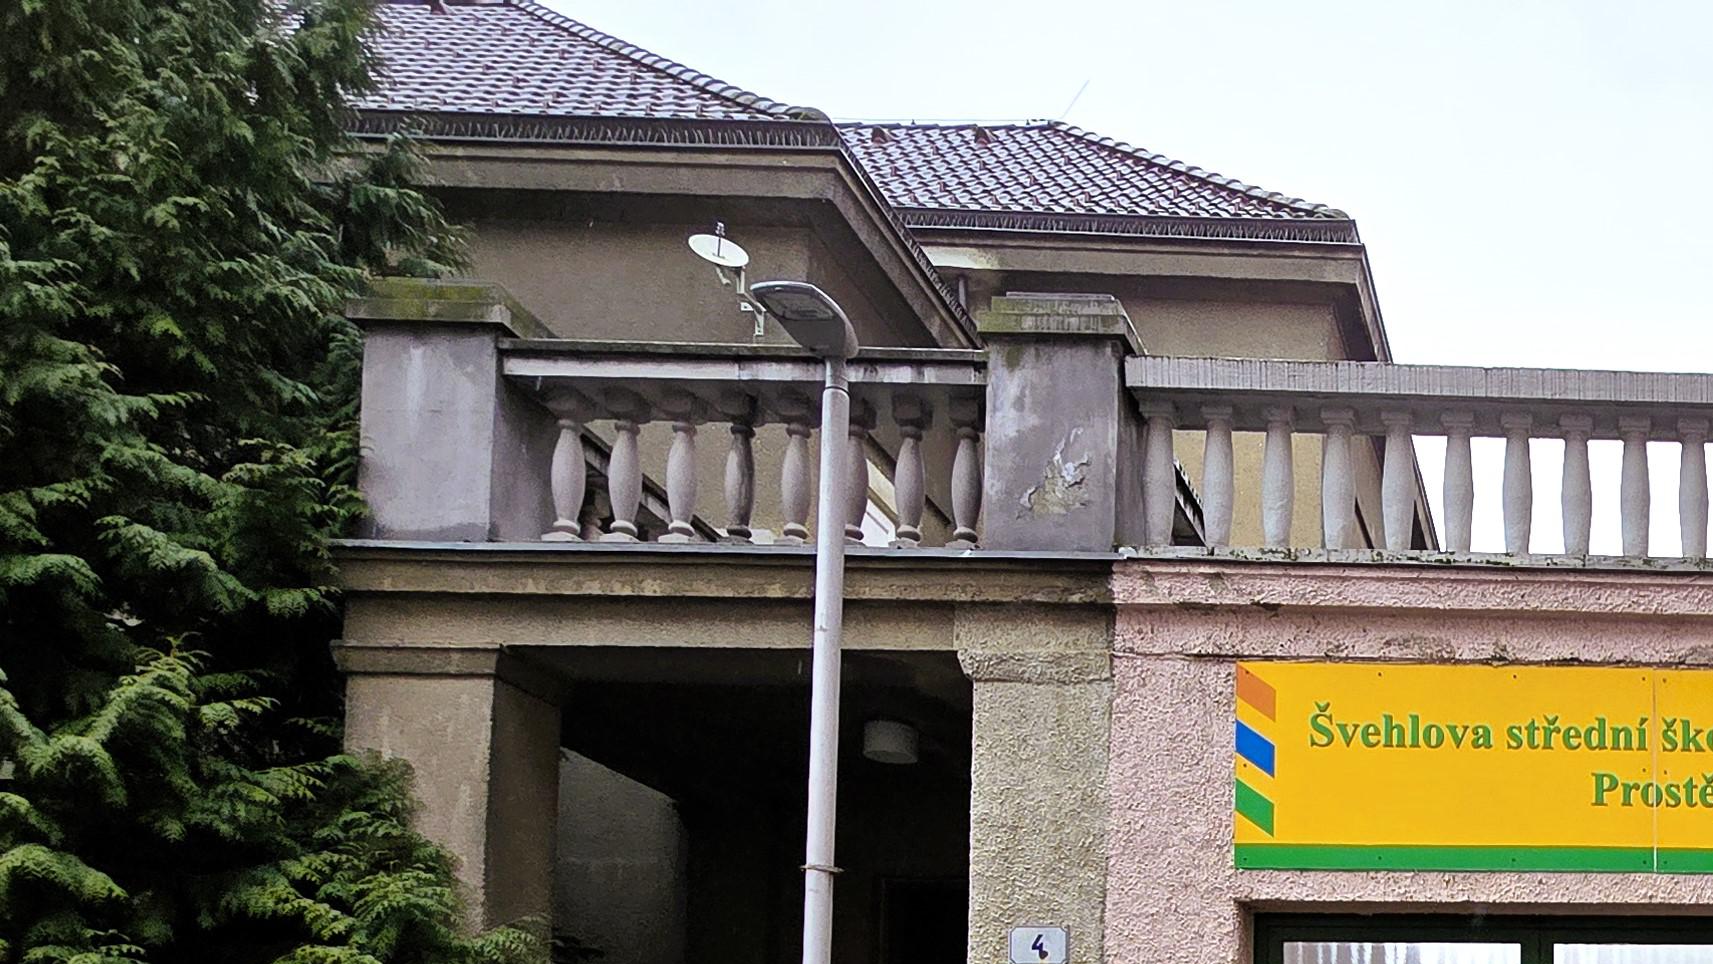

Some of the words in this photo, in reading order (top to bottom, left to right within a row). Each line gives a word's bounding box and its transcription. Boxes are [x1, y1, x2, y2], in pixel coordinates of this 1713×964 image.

[1309, 702, 1493, 749] Švehlova
[1506, 716, 1650, 750] střední
[1031, 934, 1047, 959] 4
